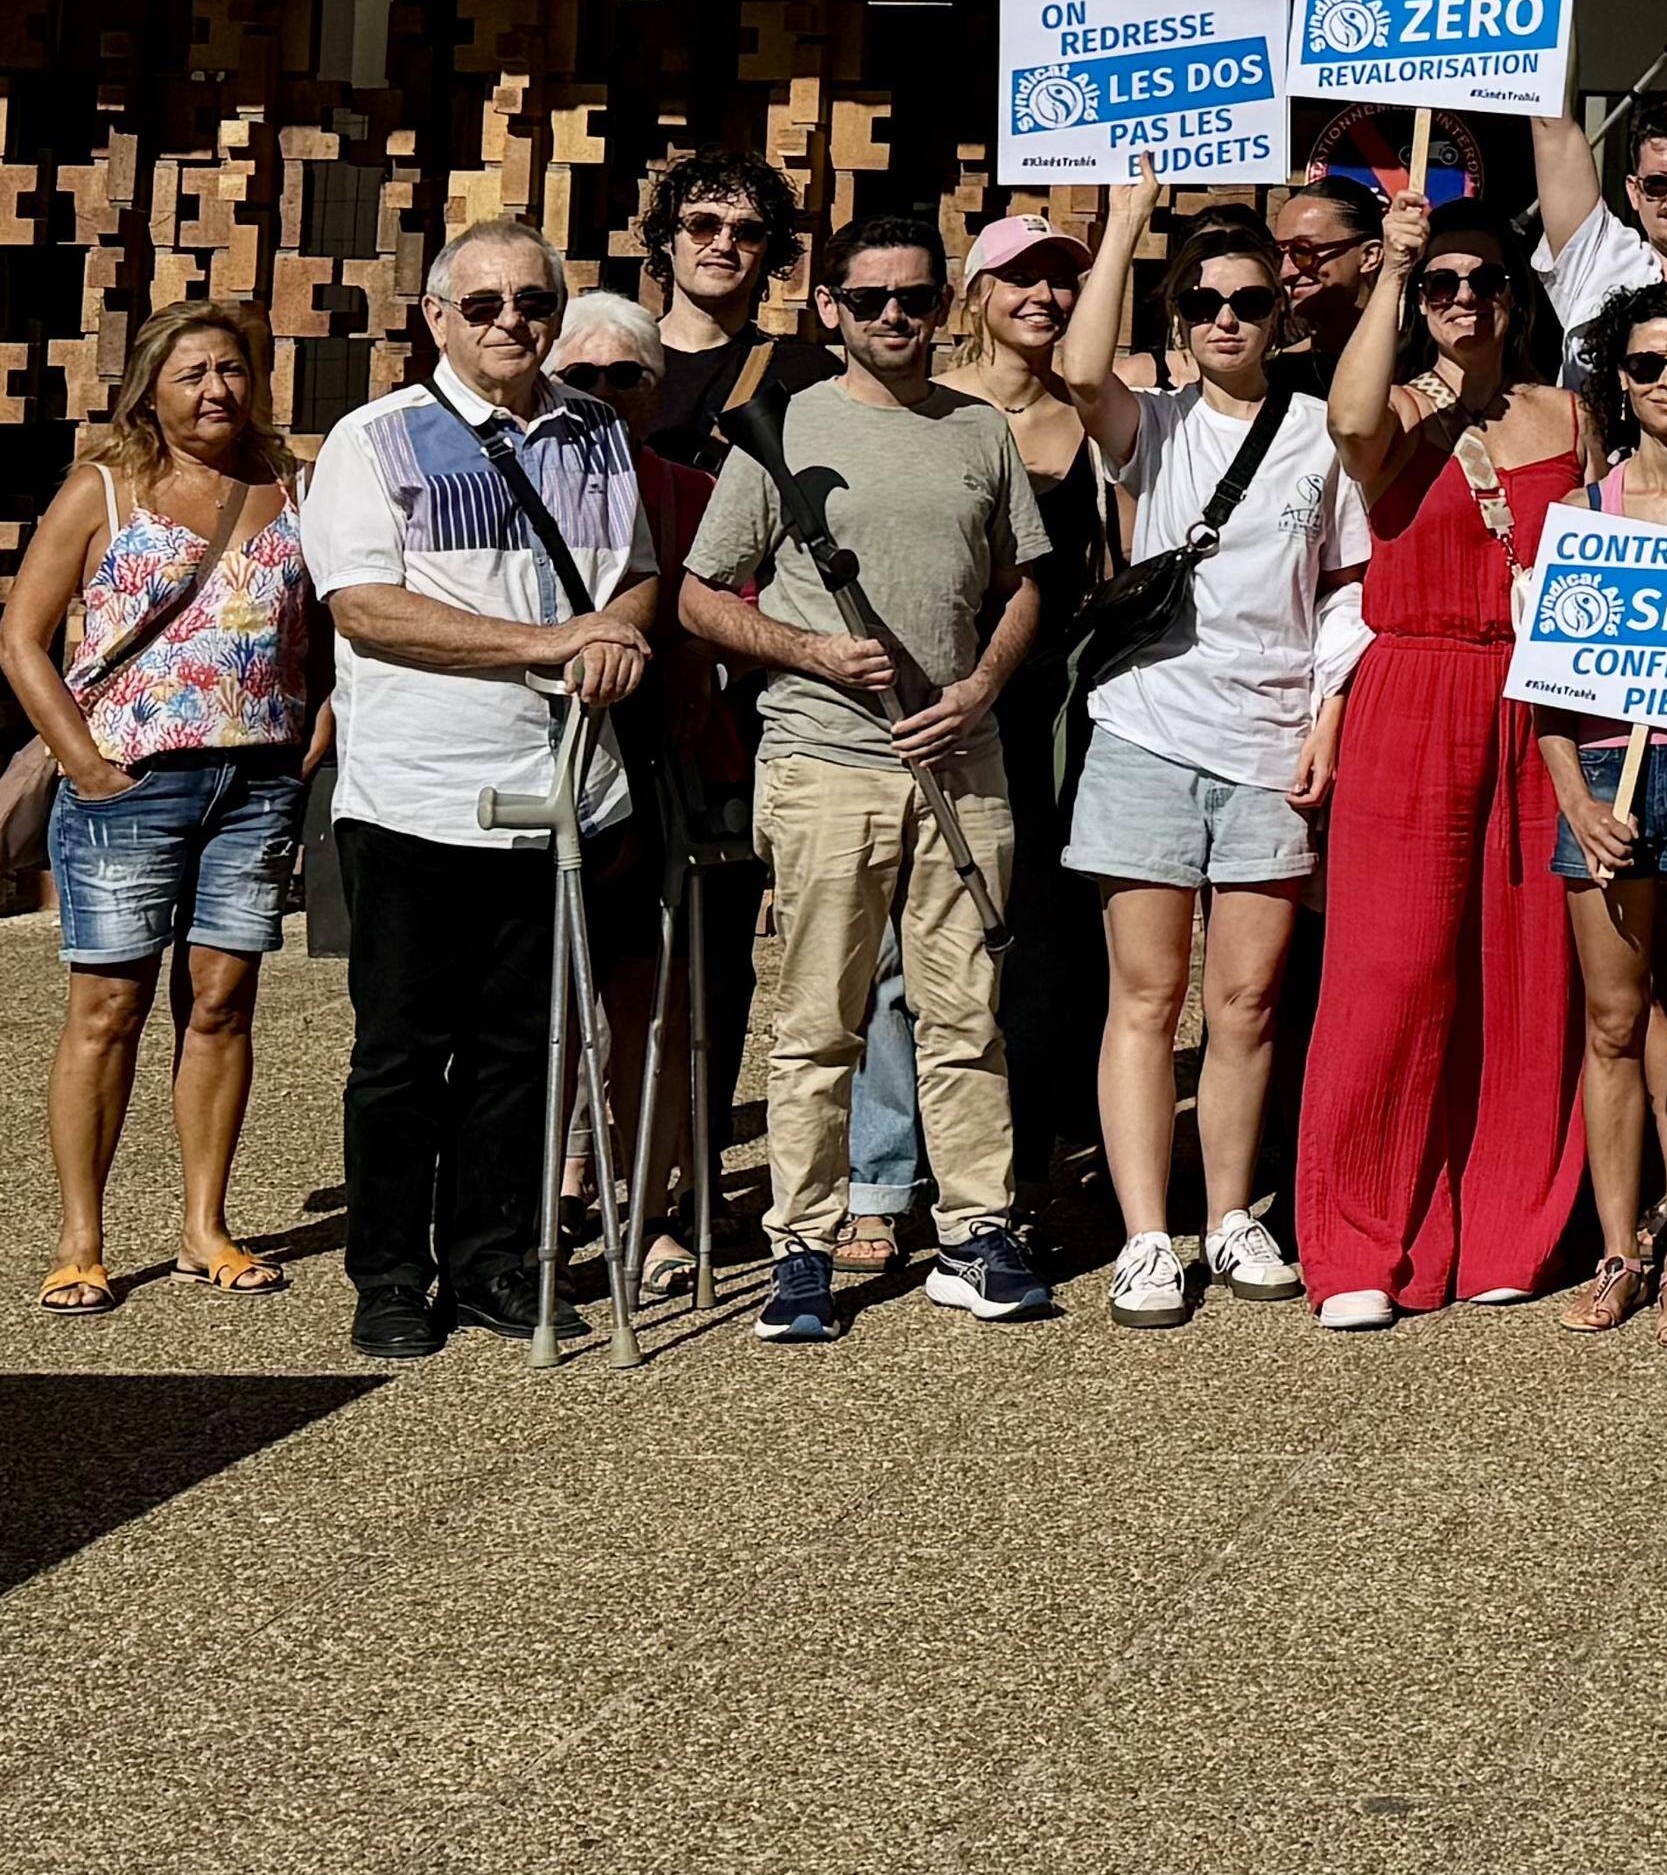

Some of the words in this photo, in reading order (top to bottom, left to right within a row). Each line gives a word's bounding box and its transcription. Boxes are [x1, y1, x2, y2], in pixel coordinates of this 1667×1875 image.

[1041, 0, 1086, 30] ON
[1060, 11, 1216, 56] REDRESSE
[1108, 66, 1175, 104] LES
[1186, 53, 1264, 93] DOS
[1317, 52, 1539, 88] REVALORISATION
[1109, 117, 1169, 149] PAS
[1179, 107, 1233, 139] LES
[1128, 133, 1271, 178] BUDGETS
